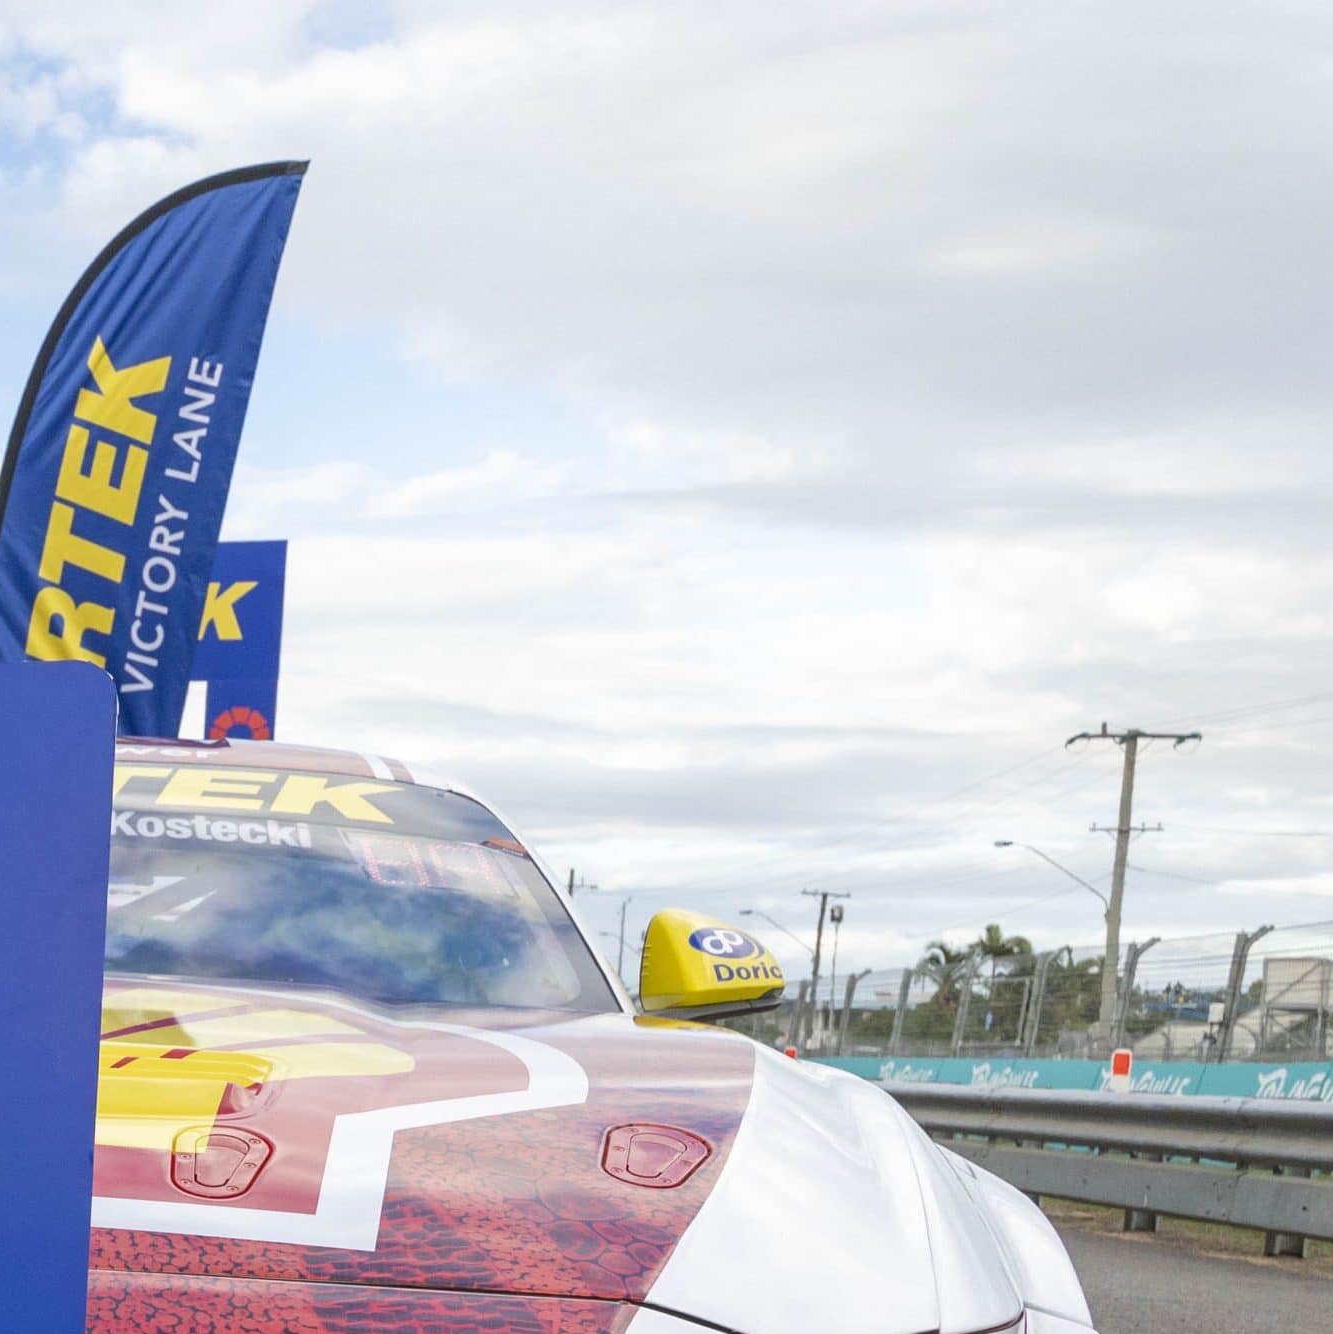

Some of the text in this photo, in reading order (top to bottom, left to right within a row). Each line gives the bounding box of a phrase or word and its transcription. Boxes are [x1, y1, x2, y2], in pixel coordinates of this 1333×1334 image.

[119, 355, 224, 693] VICTORY LANE
[111, 810, 312, 849] Kostecki
[713, 960, 783, 982] Doric
